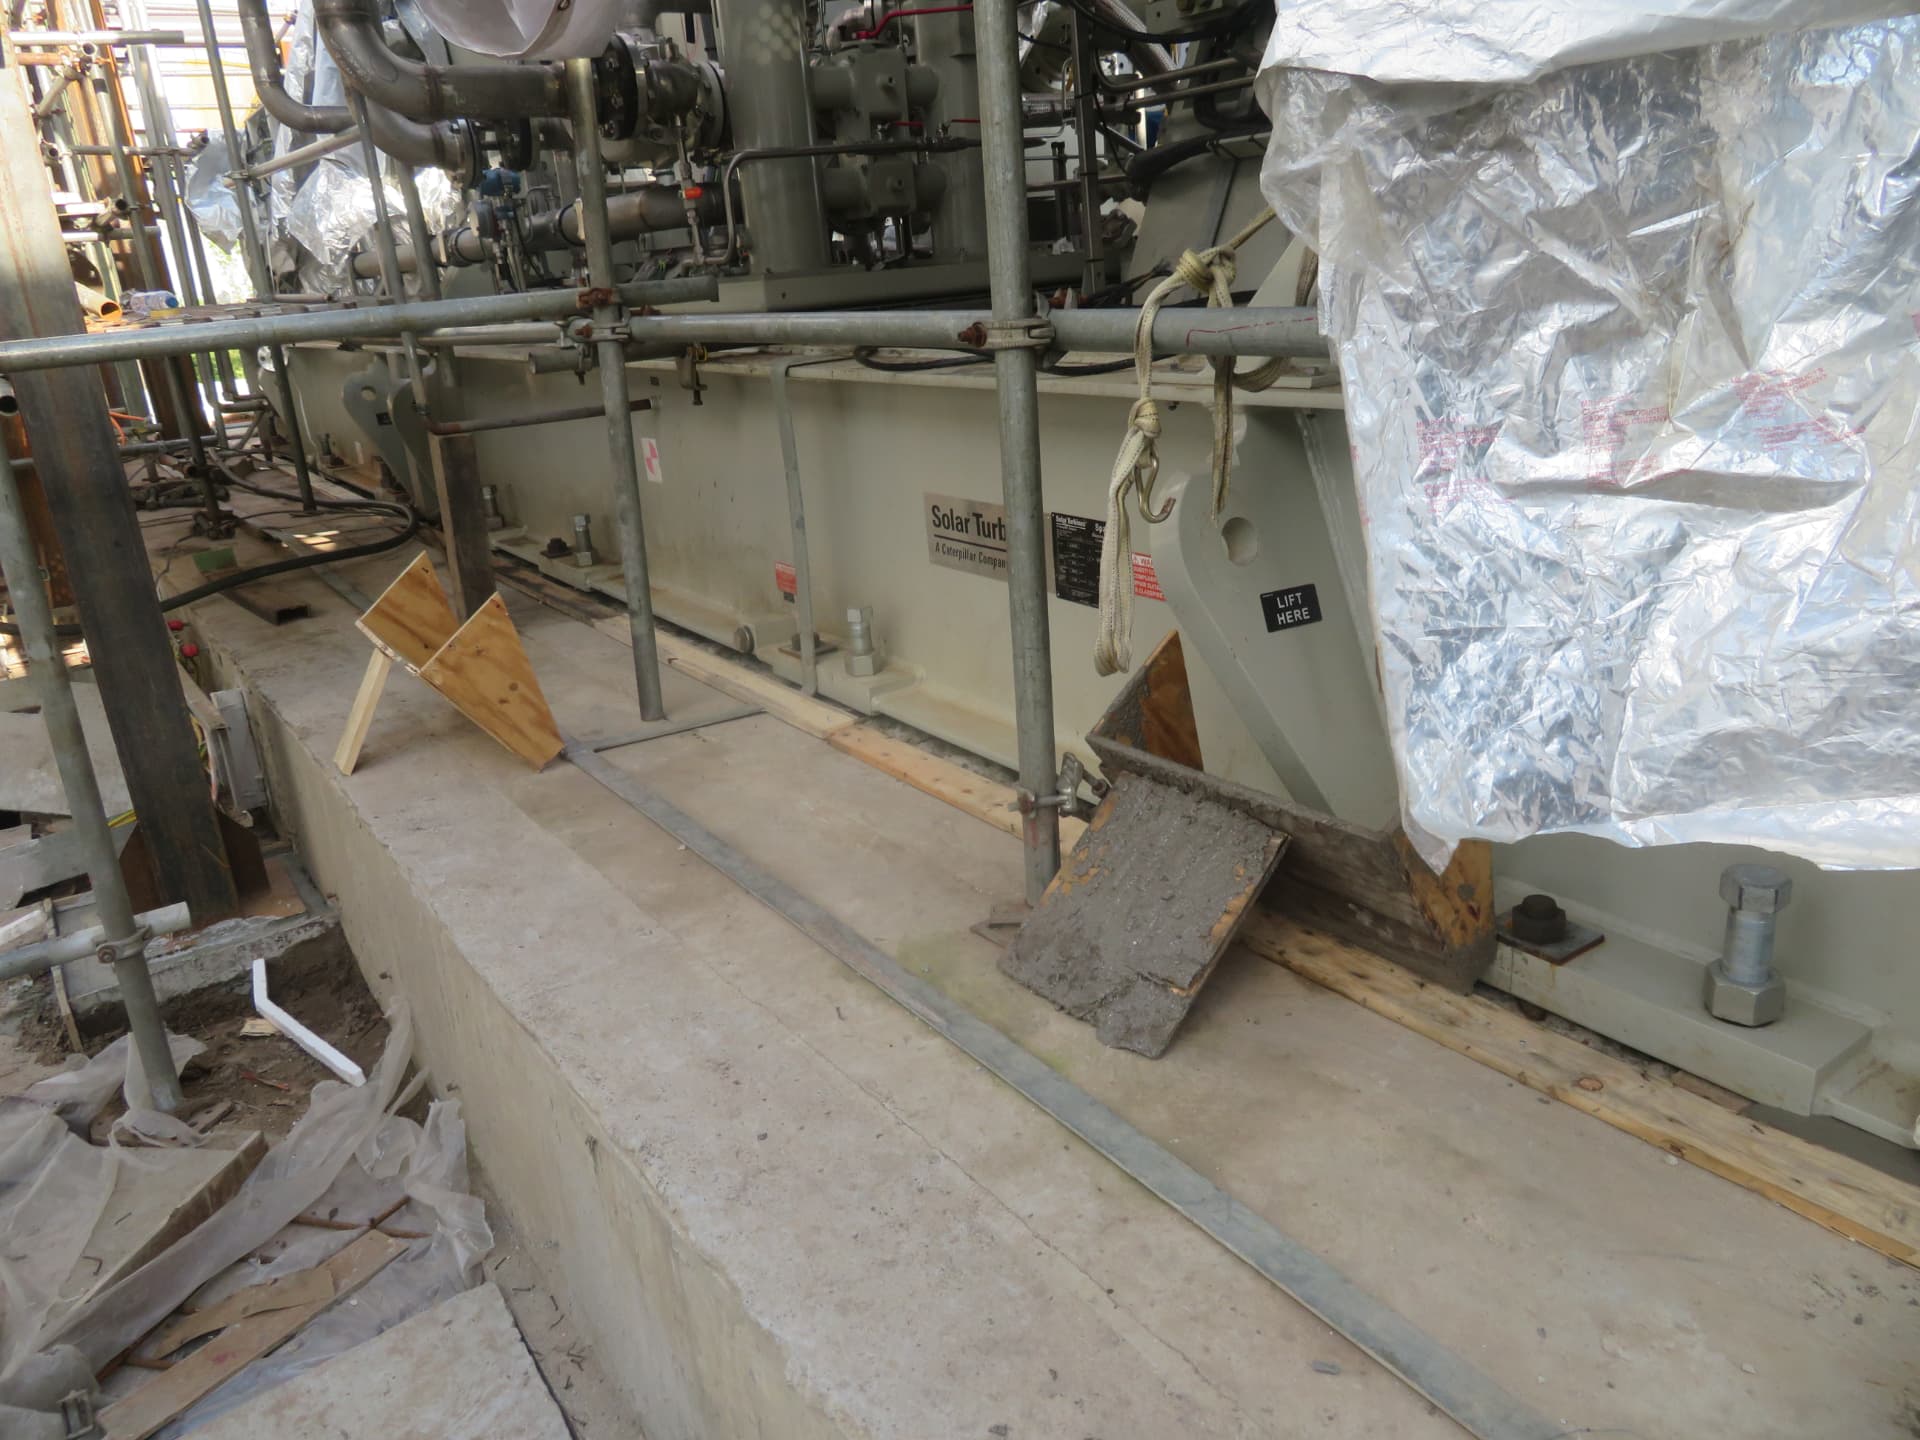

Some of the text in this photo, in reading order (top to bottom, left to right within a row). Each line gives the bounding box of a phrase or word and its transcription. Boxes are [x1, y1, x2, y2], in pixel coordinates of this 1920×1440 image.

[931, 504, 1007, 542] Solar Turb
[935, 541, 1007, 570] A Caterpillar Compan
[1277, 592, 1302, 609] LIFT
[1277, 607, 1311, 625] HERE
